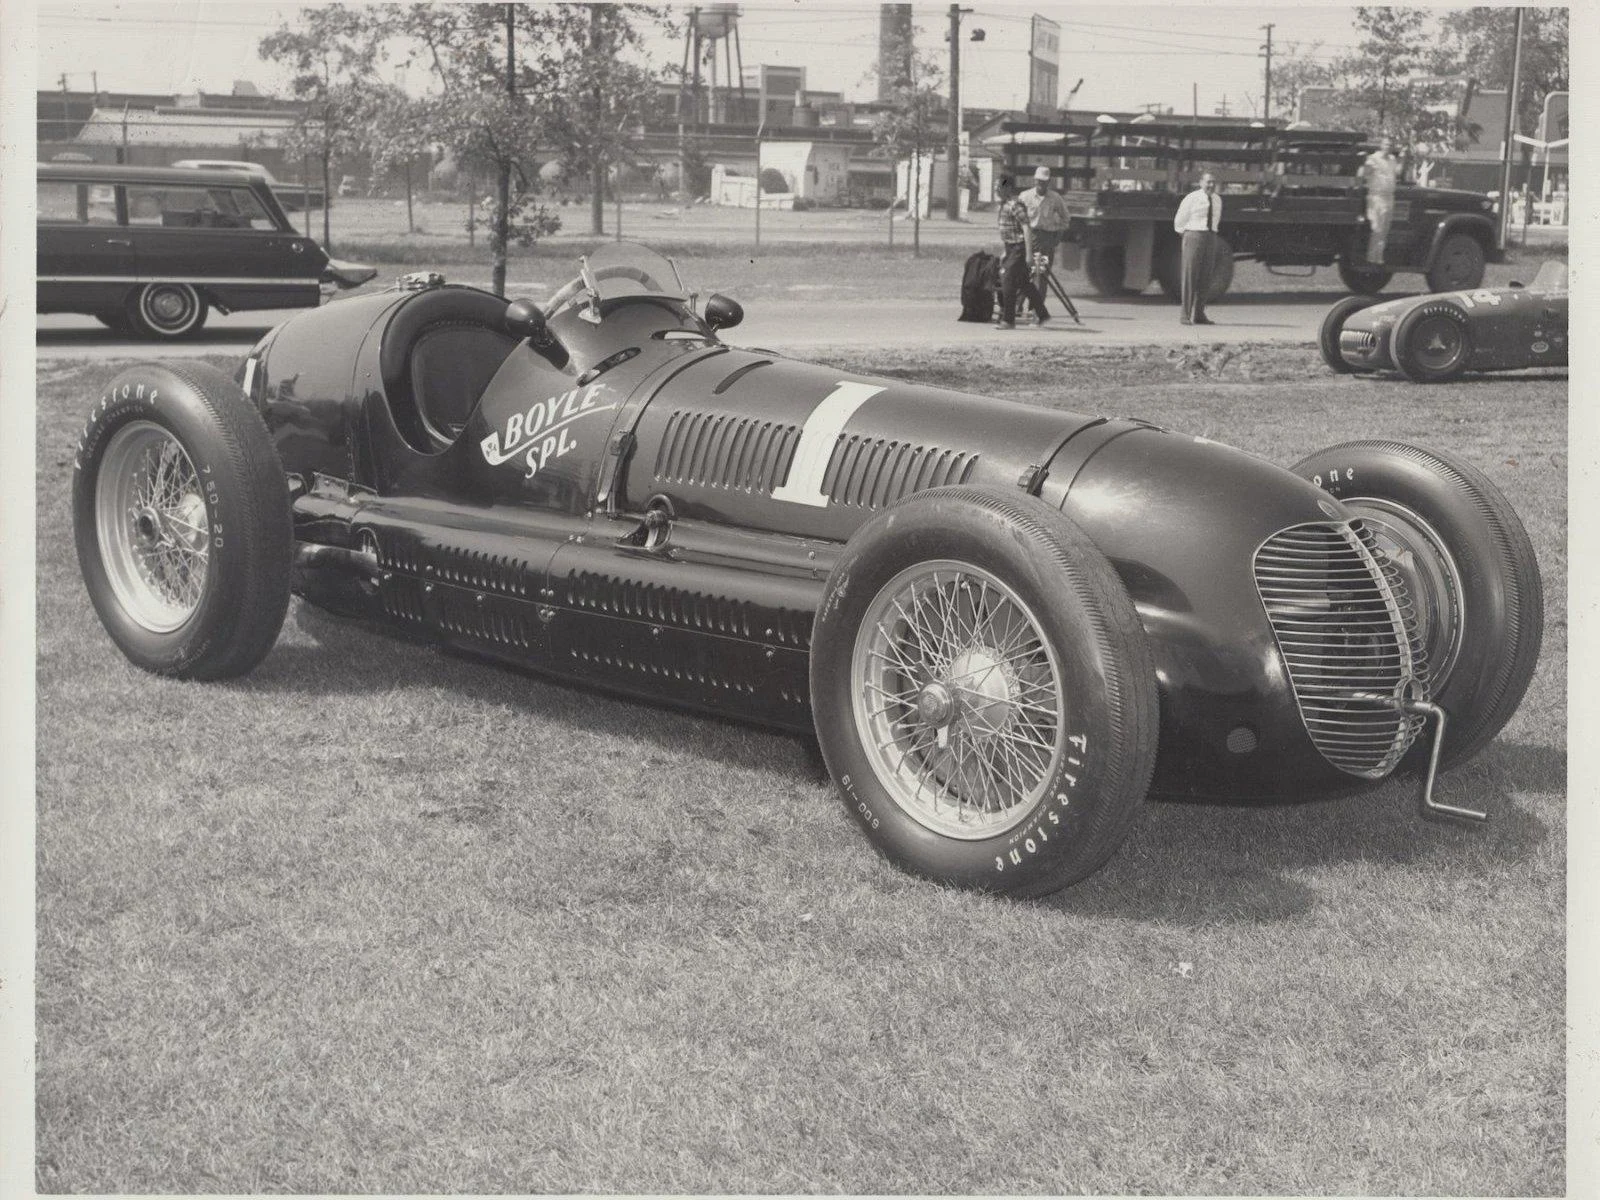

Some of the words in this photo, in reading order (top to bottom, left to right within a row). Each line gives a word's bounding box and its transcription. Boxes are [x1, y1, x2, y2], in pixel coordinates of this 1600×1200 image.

[504, 383, 607, 450] BOYLE
[771, 381, 888, 508] 1
[525, 428, 577, 479] SPL.
[841, 774, 880, 830] 600-19
[995, 734, 1087, 871] Firestone
